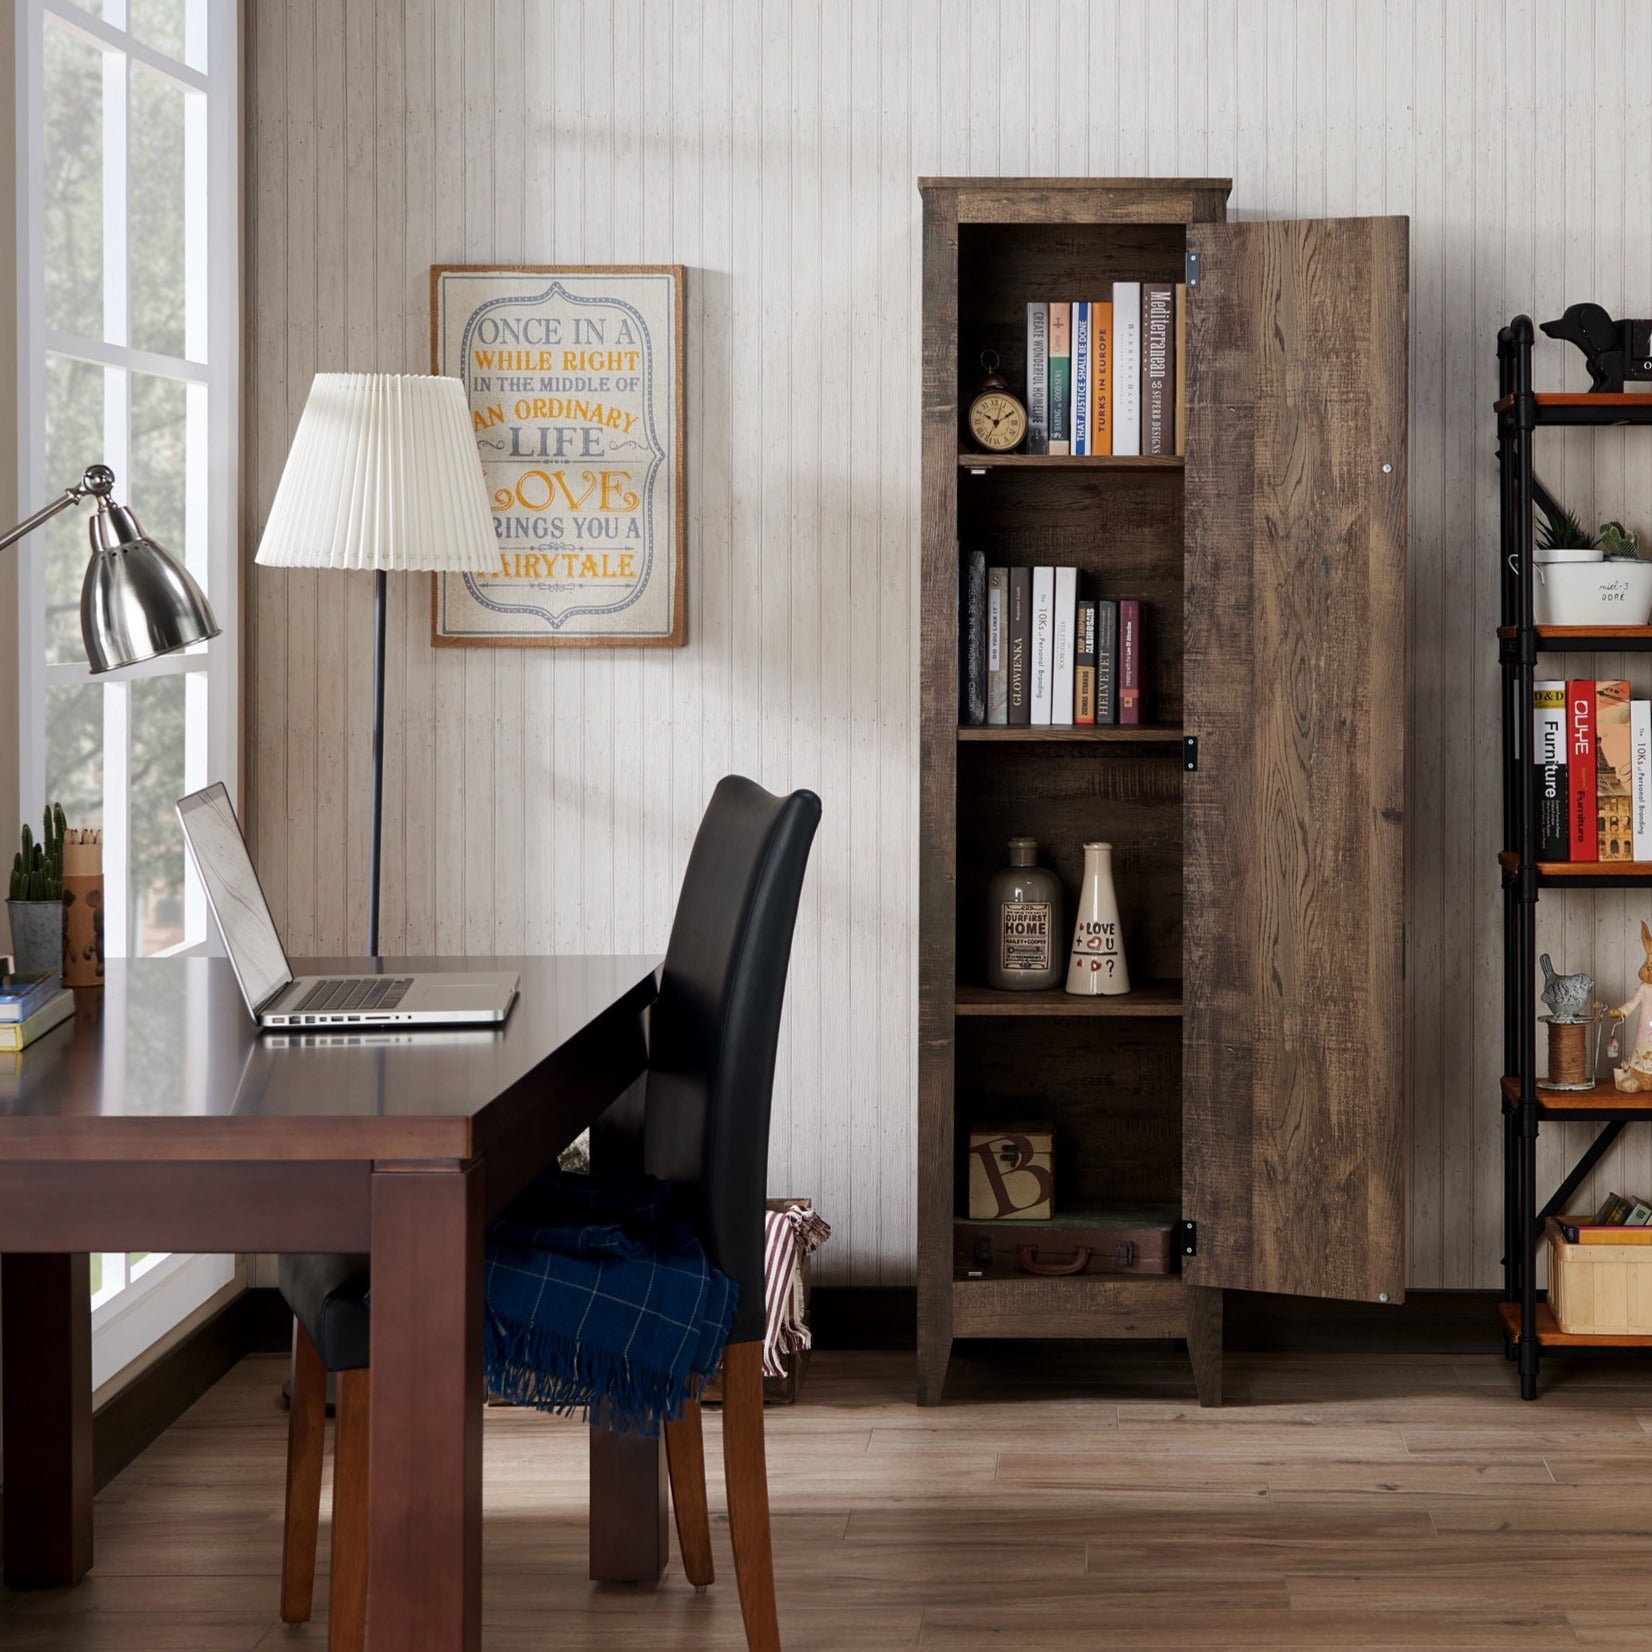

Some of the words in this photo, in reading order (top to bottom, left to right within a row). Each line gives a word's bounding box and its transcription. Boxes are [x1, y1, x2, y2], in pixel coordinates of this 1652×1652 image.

[477, 317, 561, 346] ONCE
[574, 318, 606, 346] IN
[615, 317, 636, 346] A
[1033, 312, 1044, 338] CREATE
[1078, 320, 1088, 342] DONE
[1150, 290, 1172, 378] Mediterranean
[474, 351, 552, 371] WHILE
[561, 351, 640, 371] RIGHT
[1079, 343, 1087, 354] BE
[1033, 339, 1044, 385] WONDERFUL
[1078, 354, 1086, 382] SHALL
[473, 377, 491, 392] IN
[496, 377, 534, 392] THE
[539, 377, 610, 392] MIDDLE
[616, 377, 640, 392] OF
[1099, 379, 1106, 392] IN
[1032, 387, 1044, 424] HOMELIFE
[1077, 383, 1086, 418] JUSTICE
[1152, 390, 1162, 420] SUPERB
[474, 402, 505, 432] AN
[514, 398, 639, 434] ORDINARY
[509, 426, 605, 458] LIFE
[1077, 420, 1085, 441] THAT
[1152, 422, 1162, 454] DESIGNS
[493, 516, 564, 539] RINGS
[573, 517, 622, 539] YOU
[626, 517, 641, 539] A
[476, 553, 637, 579] AIRYTALE
[1038, 608, 1048, 630] 10Ks
[1036, 670, 1044, 699] Branding
[1534, 692, 1542, 700] D
[1544, 692, 1553, 700] &
[1556, 692, 1564, 700] D
[1544, 721, 1558, 798] Furniture
[1637, 742, 1646, 766] 10Ks
[1576, 790, 1586, 843] Furniture
[1637, 805, 1646, 835] Branding
[1006, 923, 1046, 934] HOME
[1087, 922, 1115, 935] LOVE
[1106, 938, 1114, 950] U
[1106, 959, 1114, 978] ?
[970, 1134, 1052, 1218] B
